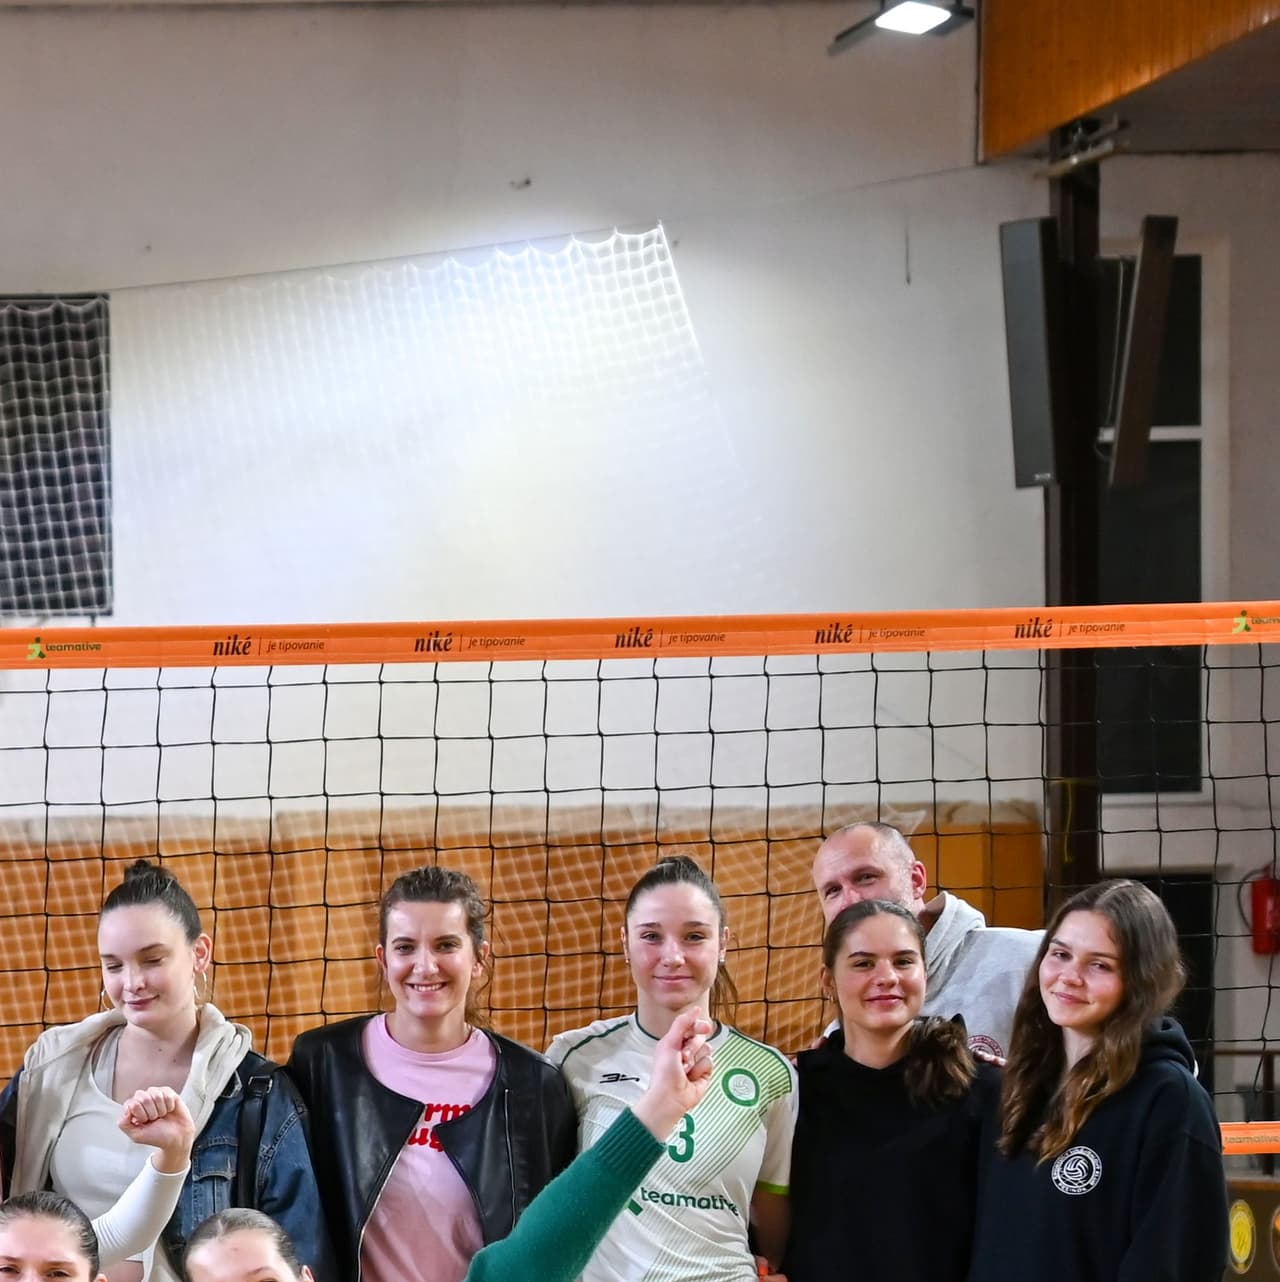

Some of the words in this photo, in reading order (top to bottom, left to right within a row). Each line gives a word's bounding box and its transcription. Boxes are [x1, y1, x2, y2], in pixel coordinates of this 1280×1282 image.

[614, 626, 654, 648] niké
[680, 631, 725, 644] tipovanie
[814, 622, 854, 644] niké
[880, 627, 925, 640] tipovanie
[1014, 616, 1053, 639] niké
[1079, 621, 1124, 634] tipovanie
[45, 642, 102, 652] teamative
[212, 634, 252, 656] niké
[278, 639, 323, 652] tipovanie
[414, 630, 453, 652] niké
[479, 635, 524, 648] tipovanie
[668, 1112, 696, 1164] 3
[640, 1186, 739, 1217] teamative
